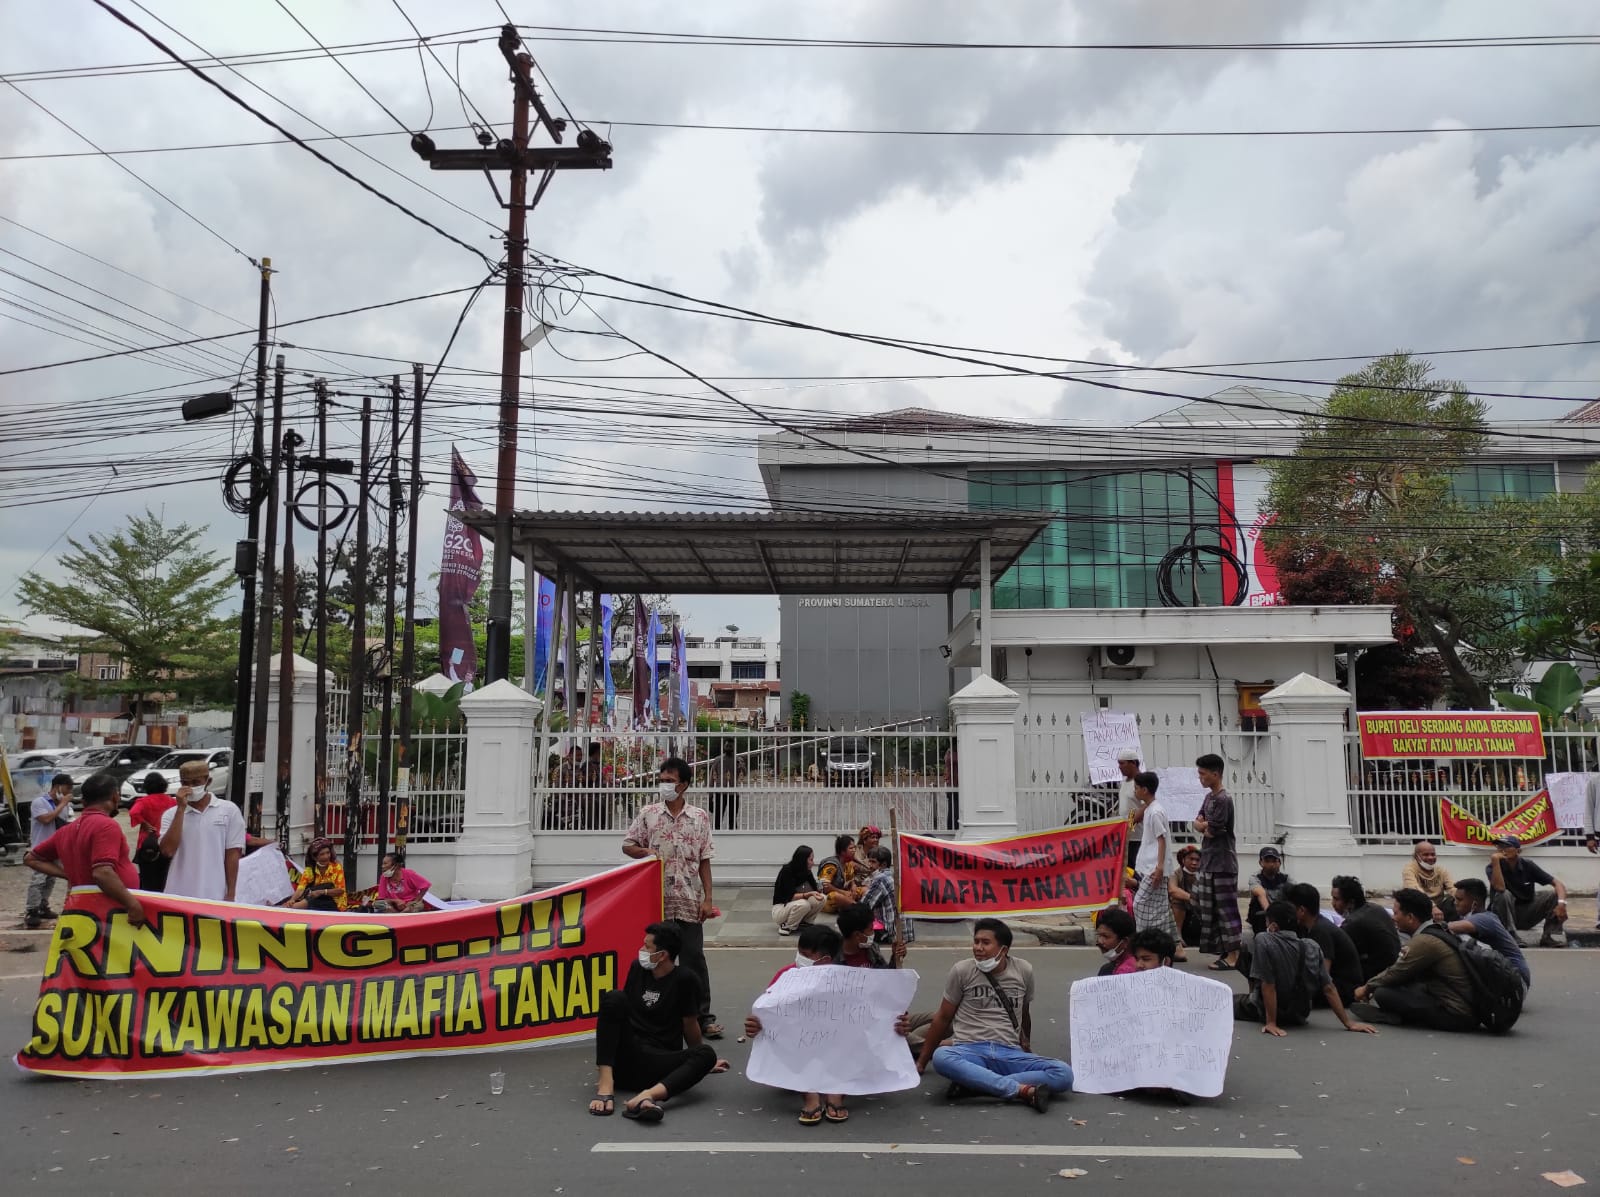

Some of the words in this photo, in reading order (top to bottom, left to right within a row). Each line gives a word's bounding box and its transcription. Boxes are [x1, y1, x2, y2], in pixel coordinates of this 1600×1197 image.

[799, 597, 841, 608] PROVINSI
[844, 597, 895, 608] SUMATERA
[1251, 593, 1275, 607] BPN
[1365, 720, 1398, 734] BUPATI
[1399, 720, 1419, 734] DELI
[1421, 720, 1463, 734] SERDANG
[1465, 720, 1490, 734] ANDA
[1492, 720, 1534, 734] BERSAMA
[1392, 738, 1427, 753] RAKYAT
[1430, 738, 1453, 753] ATAU
[1455, 738, 1483, 753] MAFIA
[1484, 738, 1516, 753] TANAH
[1515, 797, 1549, 826] TIDAK
[907, 843, 938, 869] BPN
[943, 847, 979, 871] DELI
[983, 844, 1057, 872] SERDANG
[1060, 831, 1122, 865] ADALAH
[919, 877, 999, 905] MAFIA
[1002, 871, 1089, 904] TANAH
[1095, 868, 1116, 896] !!!
[26, 991, 135, 1057] SUKI
[144, 983, 352, 1055] KAWASAN
[361, 971, 484, 1041] MAFIA
[492, 953, 615, 1028] TANAH
